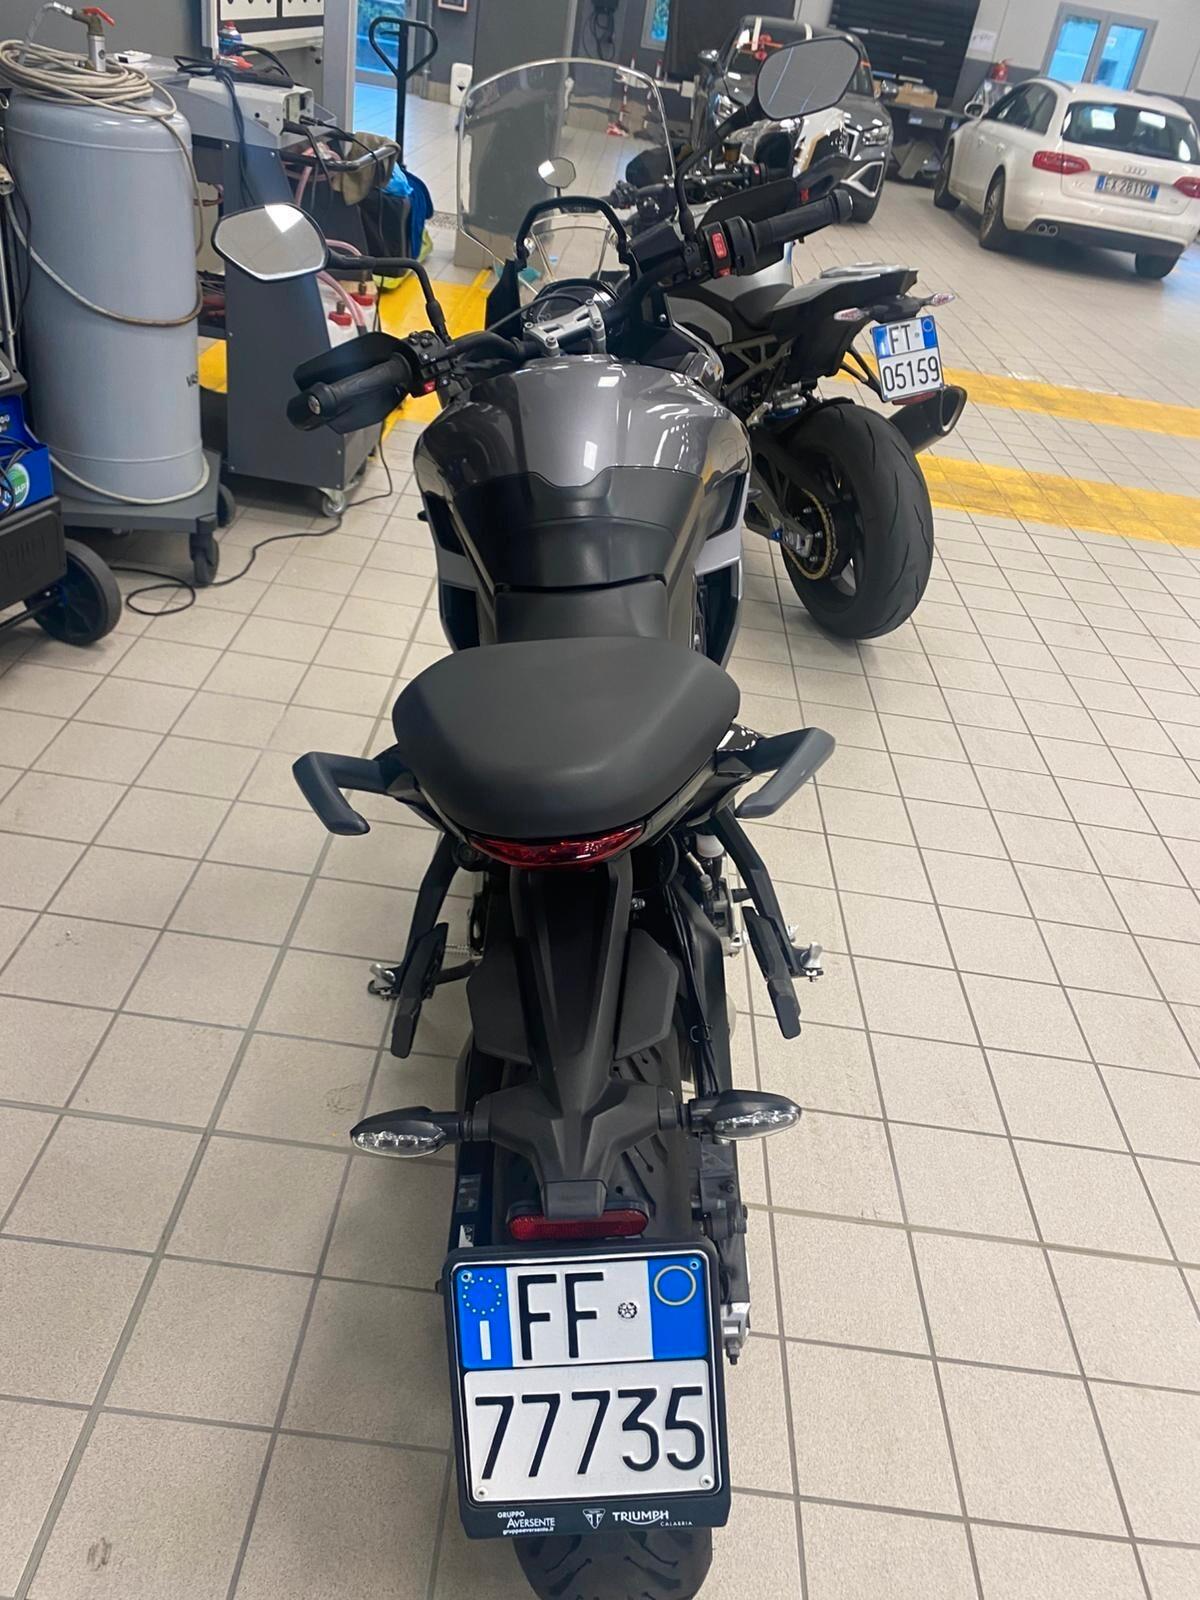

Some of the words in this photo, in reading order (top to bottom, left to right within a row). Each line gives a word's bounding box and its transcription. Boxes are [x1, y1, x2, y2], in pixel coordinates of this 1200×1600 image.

[889, 324, 910, 353] FT
[883, 356, 940, 392] 05159
[517, 1272, 605, 1361] FF
[475, 1385, 706, 1480] 77735
[497, 1510, 526, 1519] GRUPPO
[506, 1517, 556, 1529] AVERSENTE
[612, 1510, 669, 1523] TRIUMPH
